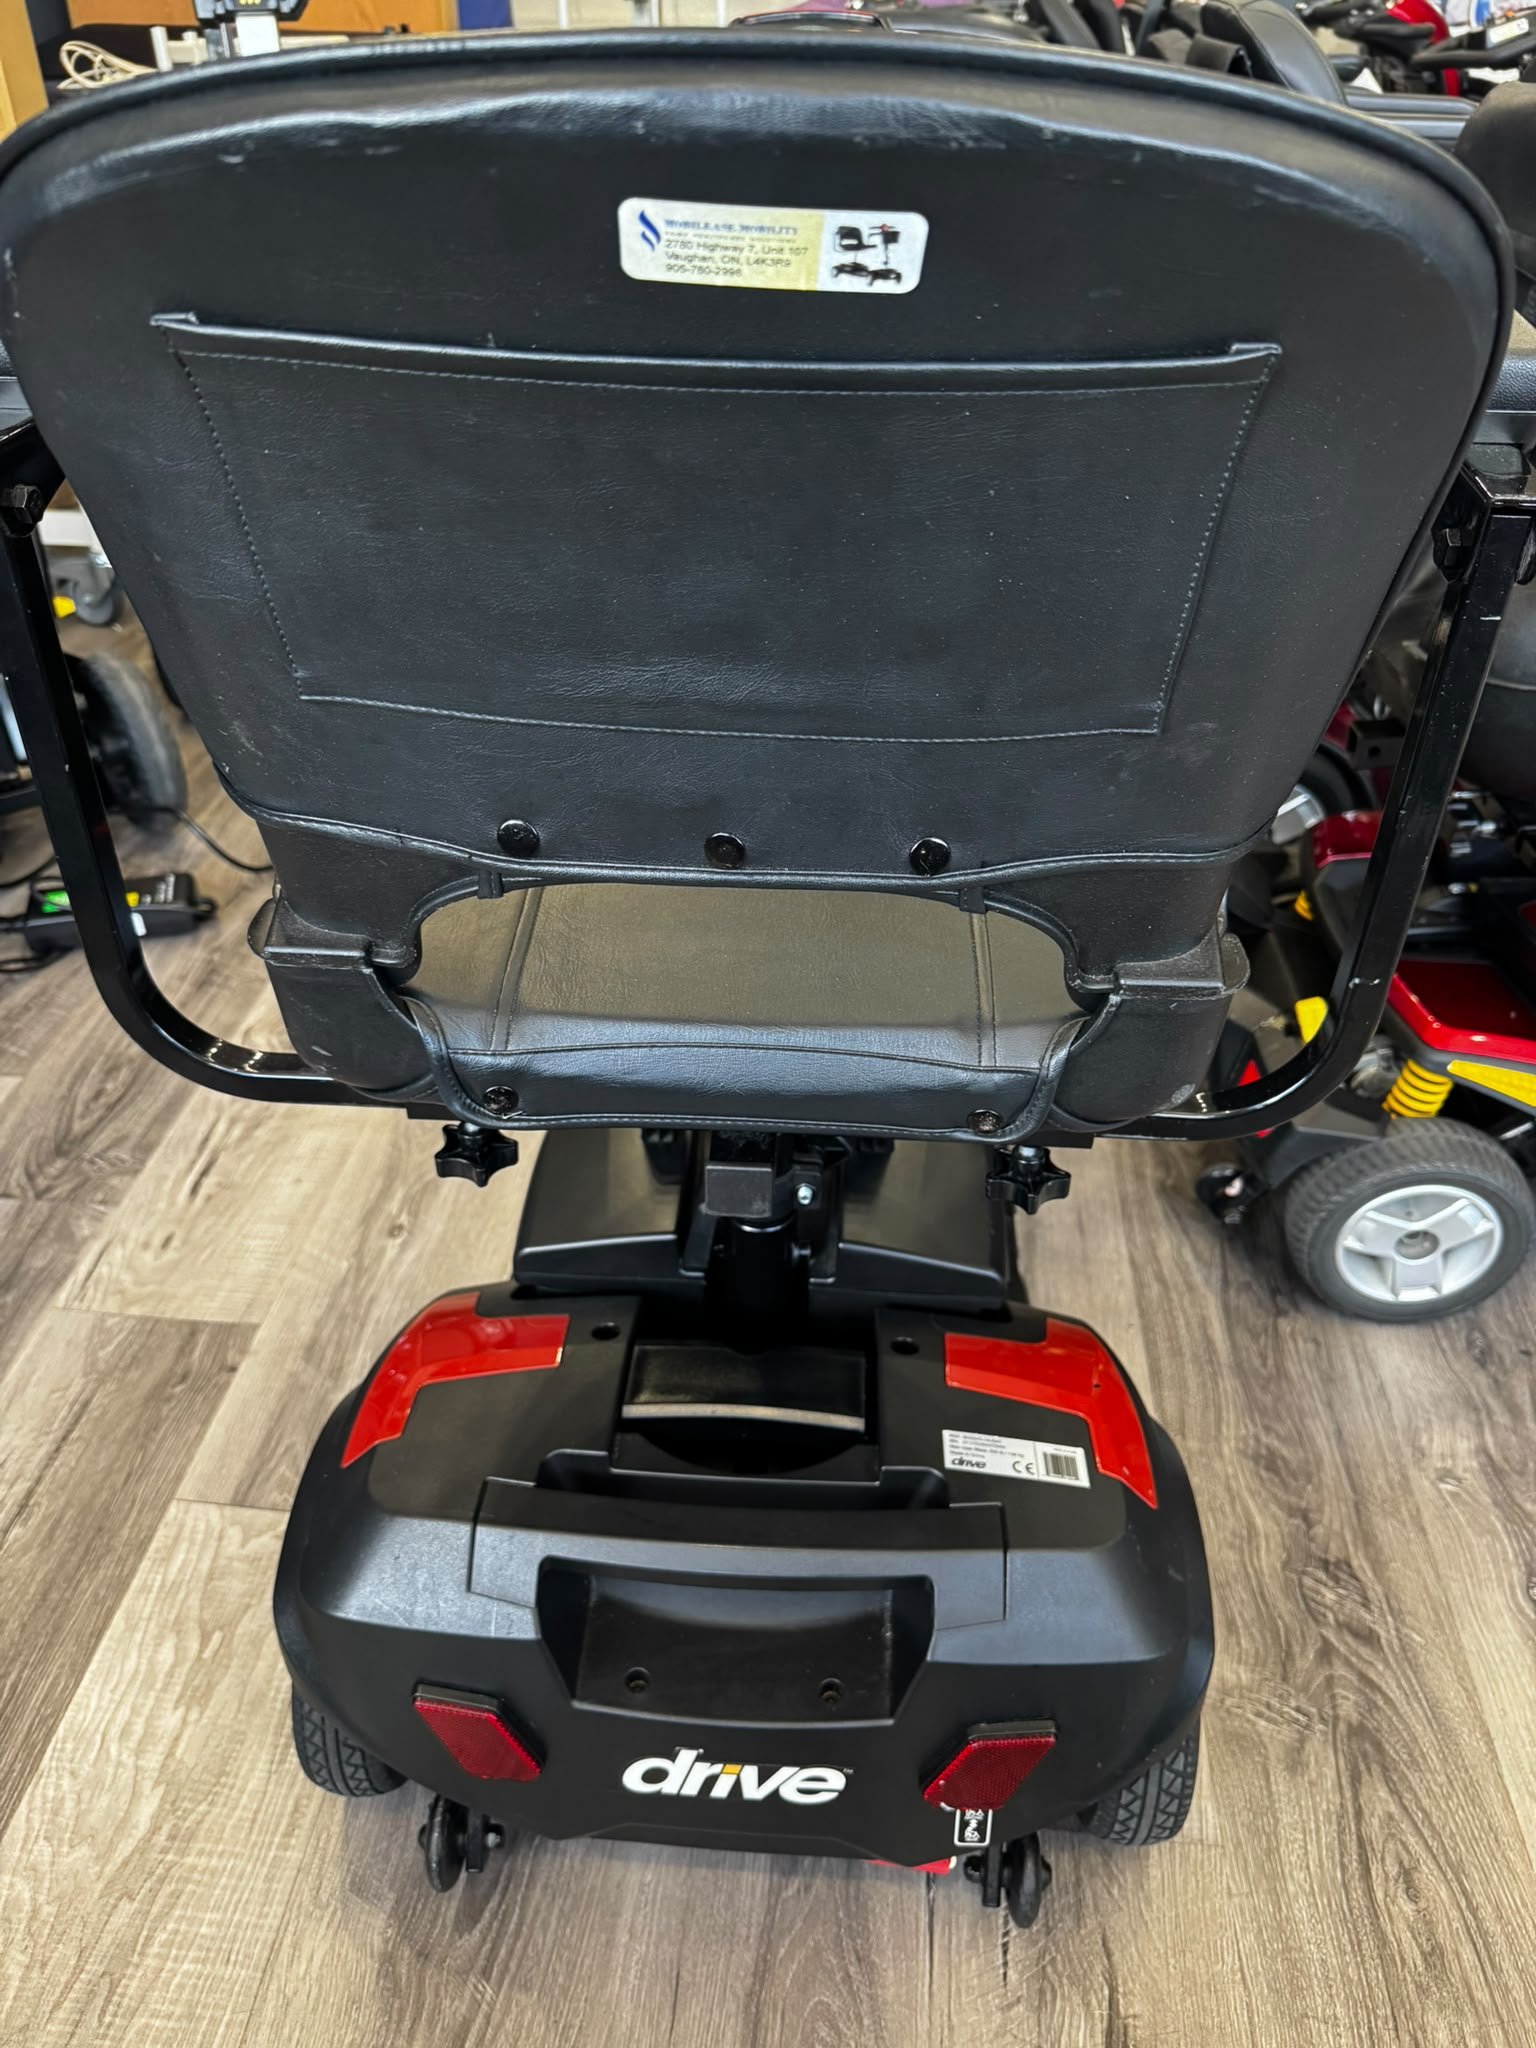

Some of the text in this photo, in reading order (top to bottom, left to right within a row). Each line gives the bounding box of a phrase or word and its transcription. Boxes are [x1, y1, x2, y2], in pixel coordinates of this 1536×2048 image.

[665, 239, 693, 250] 2780
[697, 242, 745, 255] Highway
[762, 246, 785, 256] Unit
[951, 1456, 987, 1469] drive
[622, 1747, 848, 1804] drive
